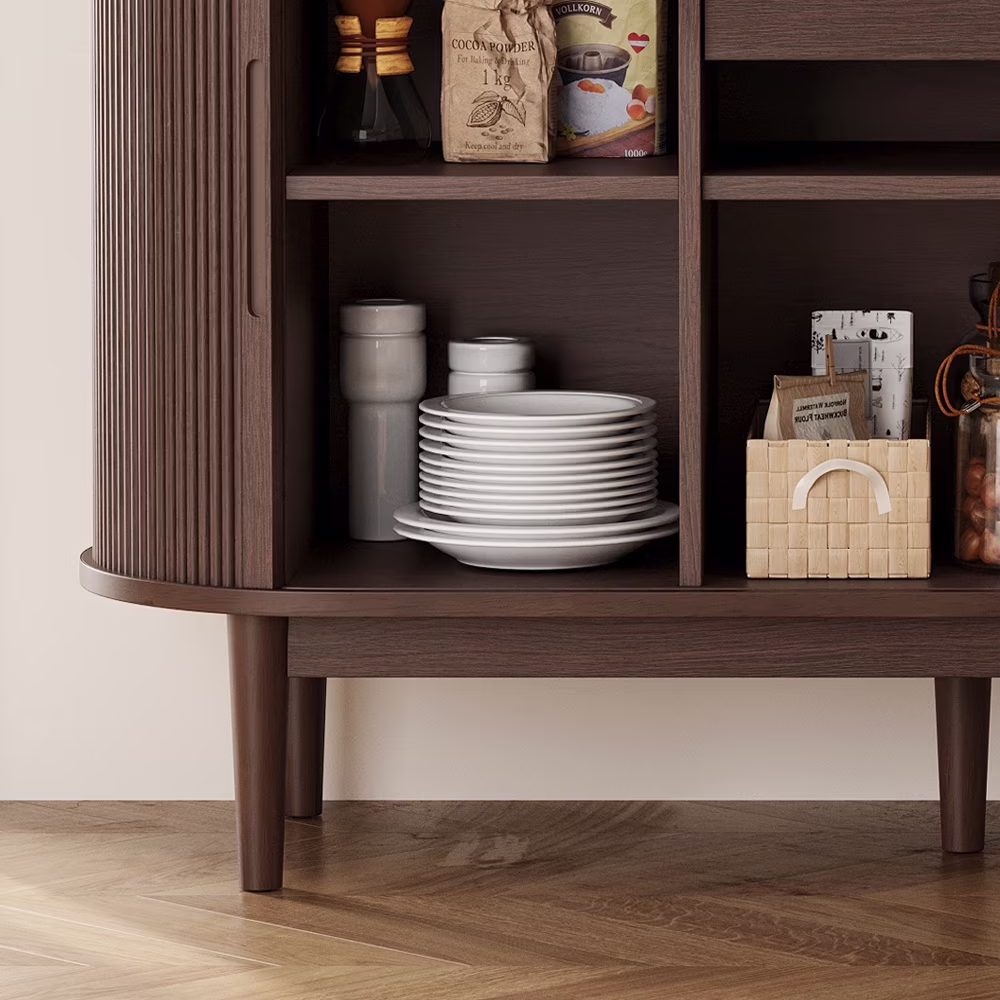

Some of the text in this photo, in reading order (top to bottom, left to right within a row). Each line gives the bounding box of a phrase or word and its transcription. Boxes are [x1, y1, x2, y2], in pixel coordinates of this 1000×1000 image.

[555, 3, 603, 16] VOLLKORN
[451, 39, 536, 53] COCOA POWDER
[457, 54, 468, 63] For
[470, 55, 493, 65] Baking
[483, 69, 511, 91] 1 kg
[465, 141, 482, 152] Keep
[483, 142, 497, 150] cool
[512, 142, 525, 152] dry
